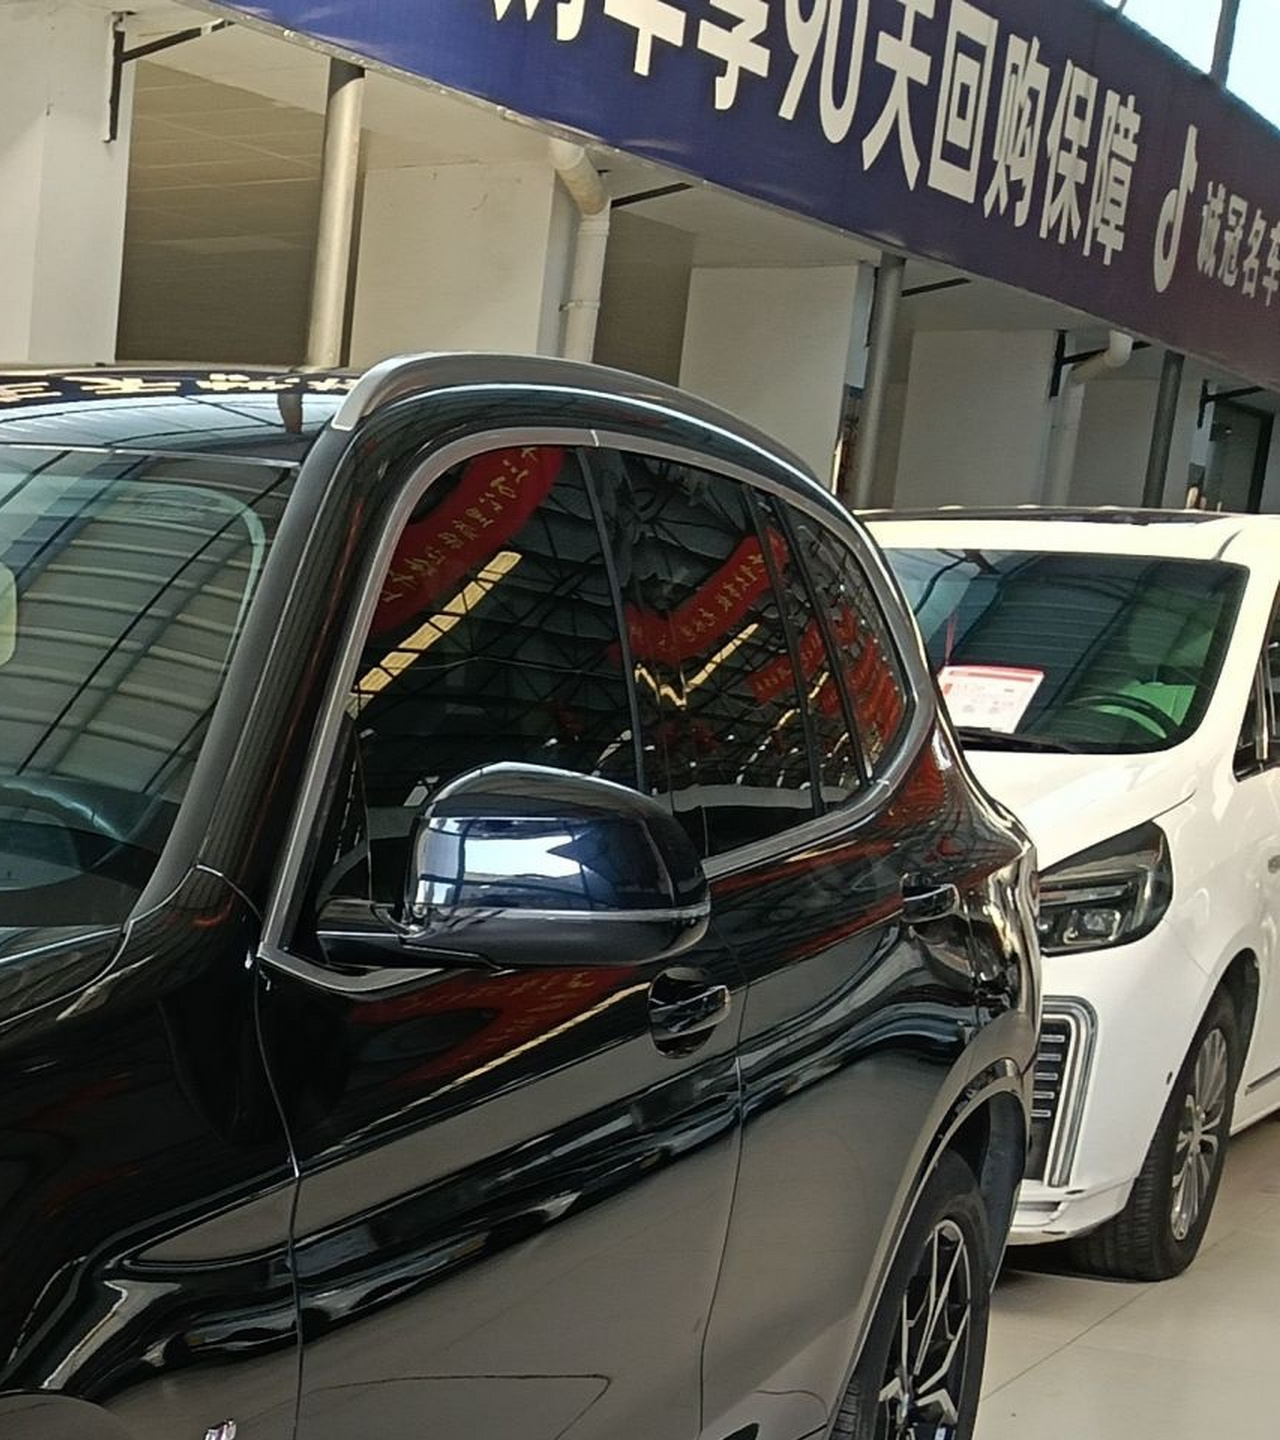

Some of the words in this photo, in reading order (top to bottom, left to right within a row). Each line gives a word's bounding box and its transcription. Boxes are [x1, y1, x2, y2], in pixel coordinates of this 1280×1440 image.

[473, 0, 1142, 267] 90天回购保障
